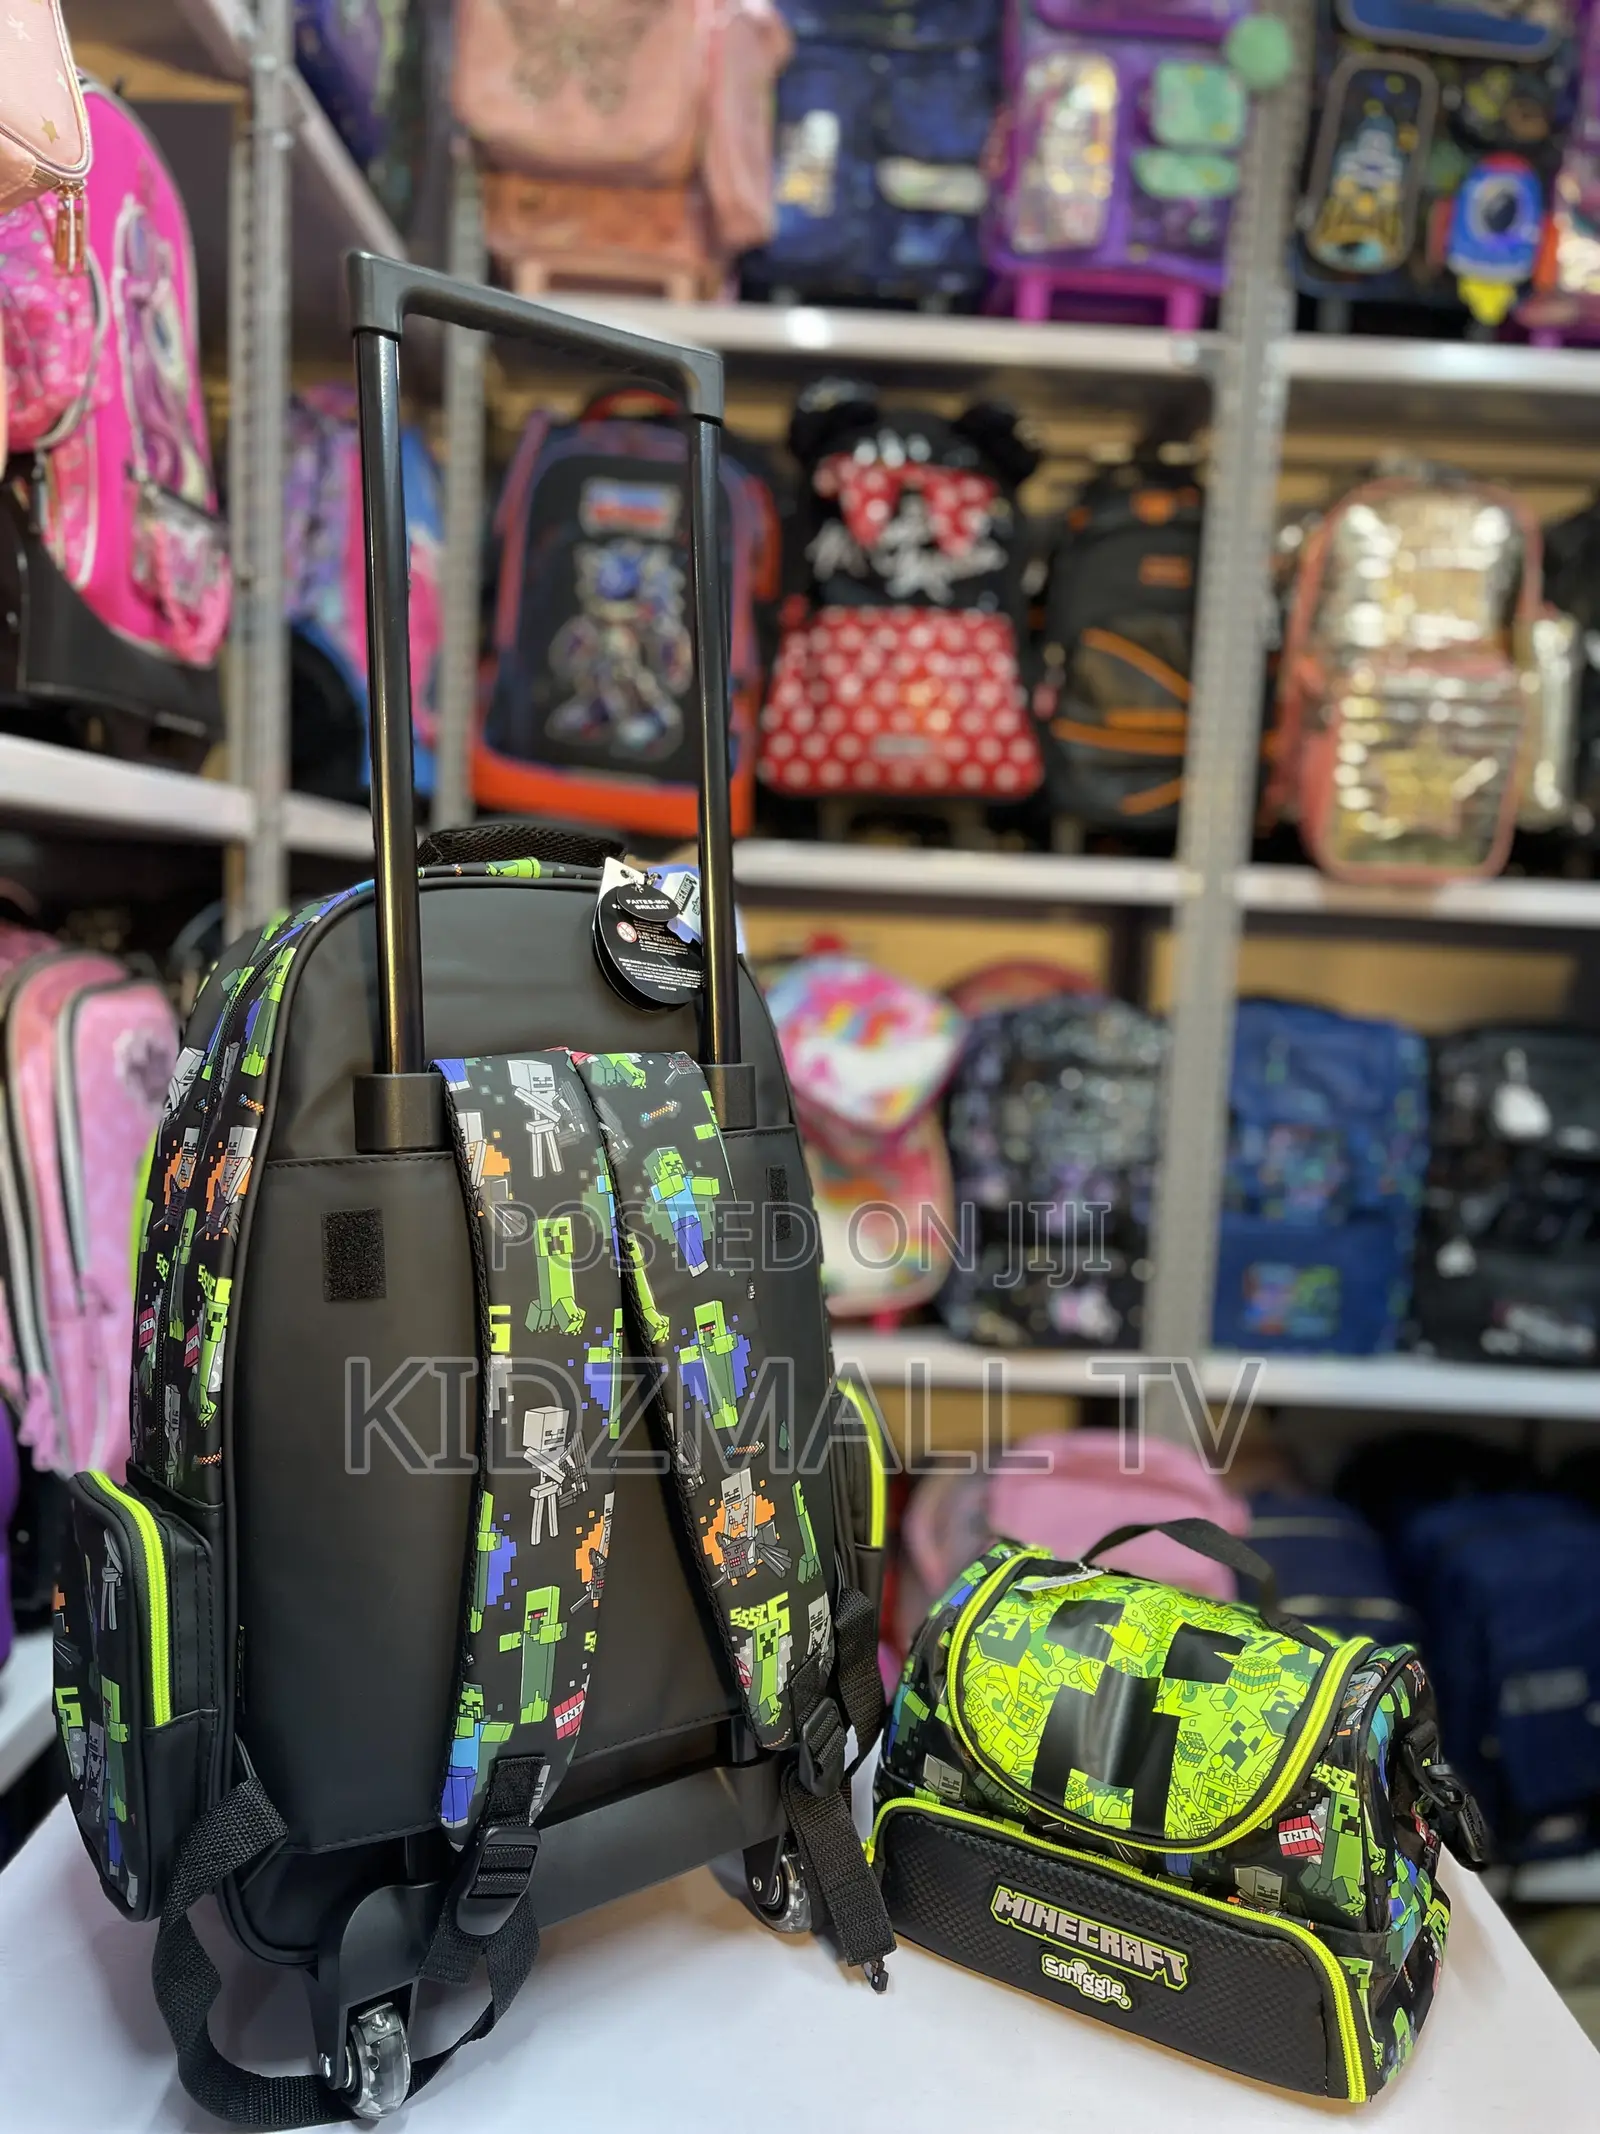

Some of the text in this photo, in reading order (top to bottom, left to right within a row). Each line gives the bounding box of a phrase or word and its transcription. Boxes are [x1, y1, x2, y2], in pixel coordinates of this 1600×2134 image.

[560, 1704, 582, 1724] TNT
[1283, 1829, 1309, 1842] TNT
[992, 1887, 1187, 1986] MINECRAFT
